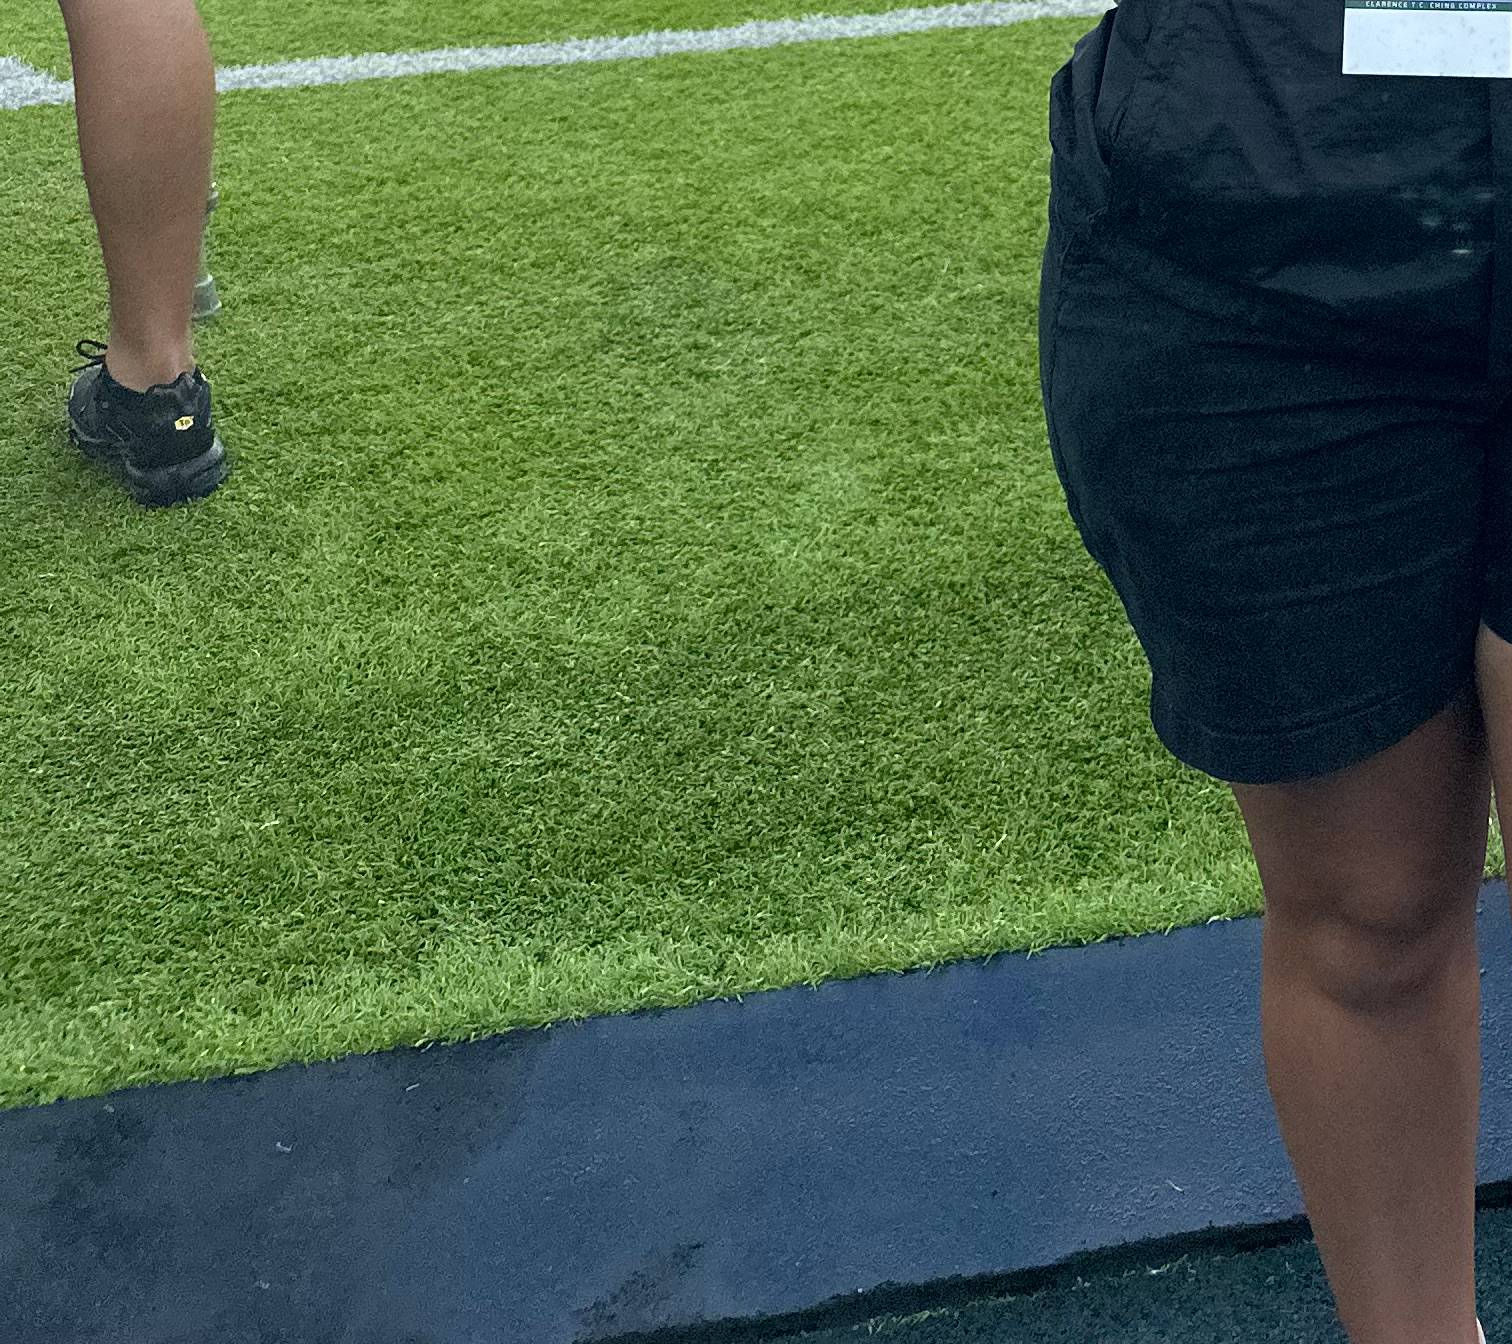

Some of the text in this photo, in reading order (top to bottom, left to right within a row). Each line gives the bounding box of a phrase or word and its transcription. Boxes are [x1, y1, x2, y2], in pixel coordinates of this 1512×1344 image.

[1365, 0, 1408, 8] CLARENCE
[1429, 1, 1456, 9] CHING
[1458, 2, 1497, 10] COMPLEX
